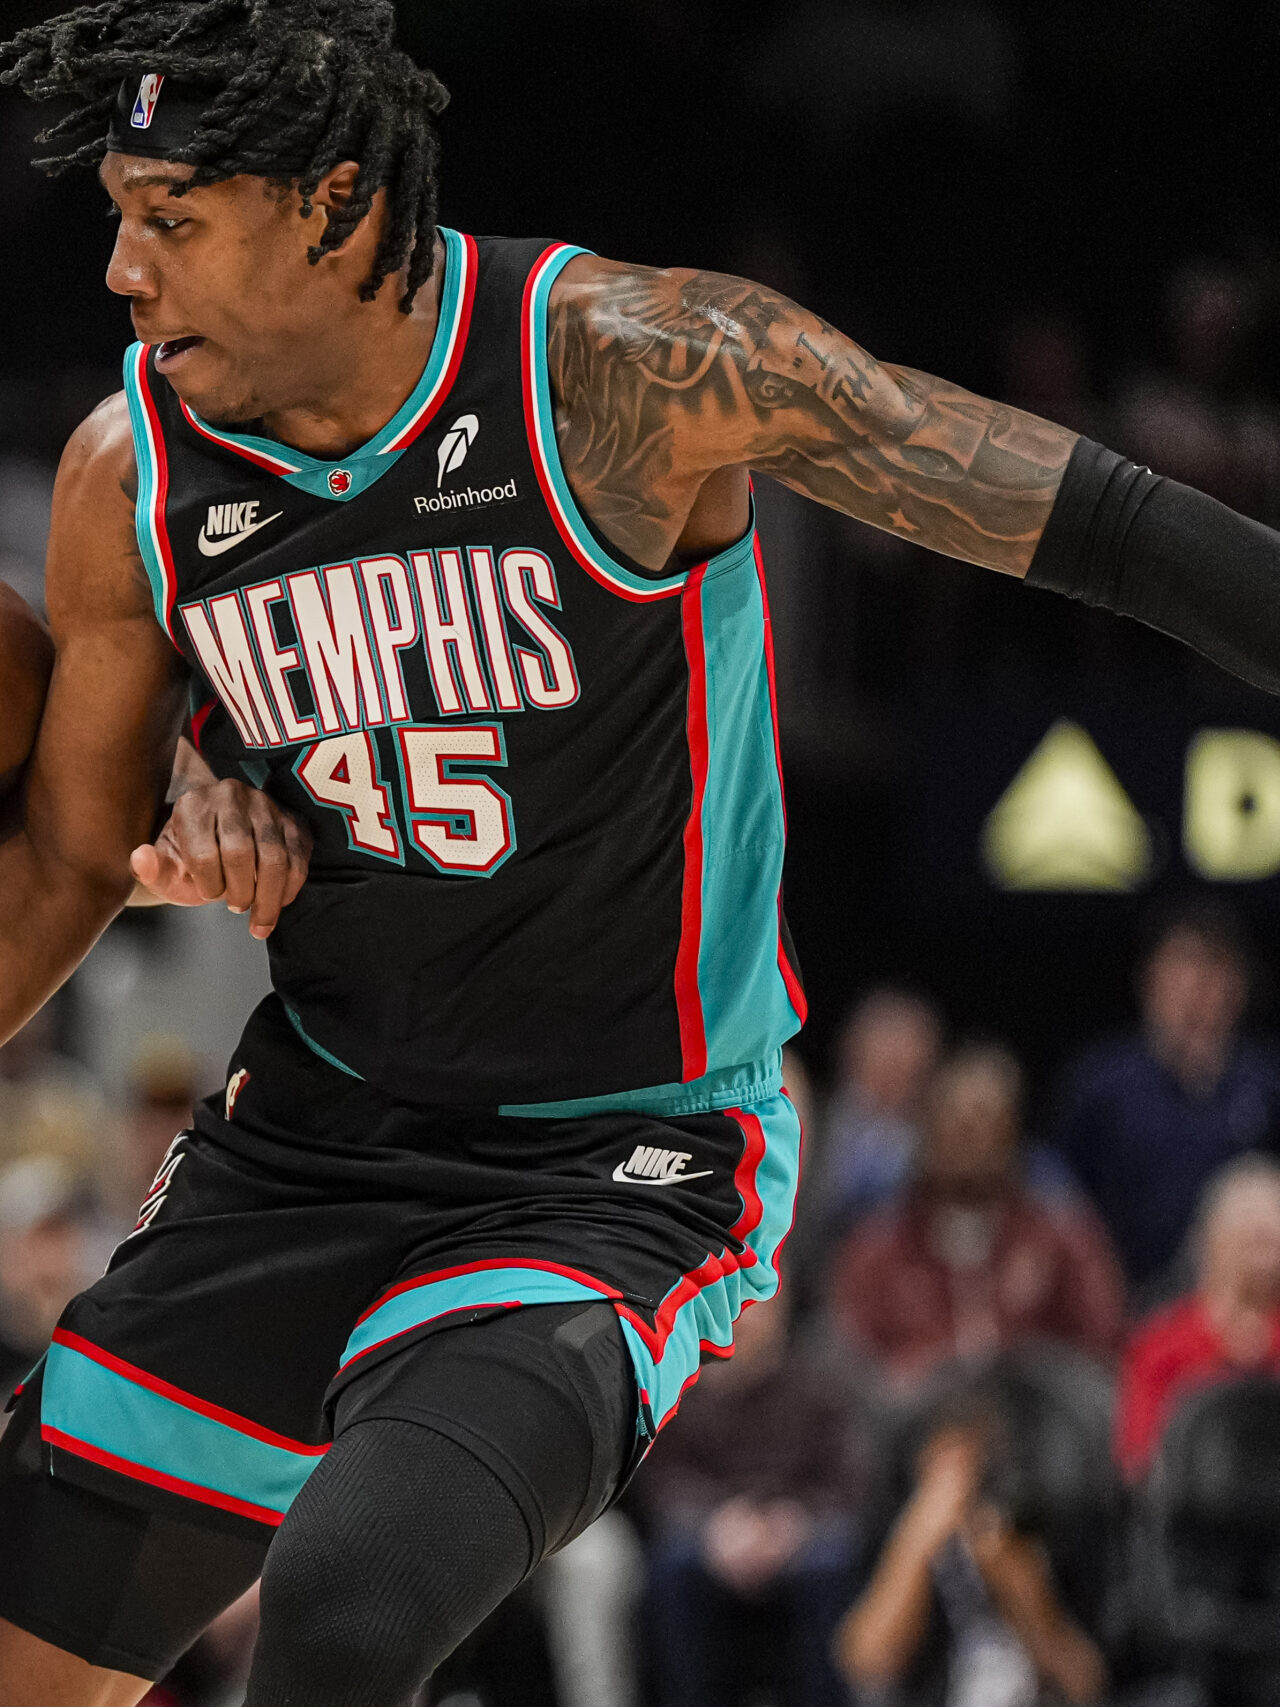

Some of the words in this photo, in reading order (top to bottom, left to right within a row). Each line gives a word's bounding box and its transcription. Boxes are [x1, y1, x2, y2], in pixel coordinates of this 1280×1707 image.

[413, 478, 517, 514] Robinhood
[206, 500, 260, 536] NIKE
[178, 545, 582, 749] MEMPHIS
[291, 721, 517, 878] 45
[623, 1145, 693, 1179] NIKE
